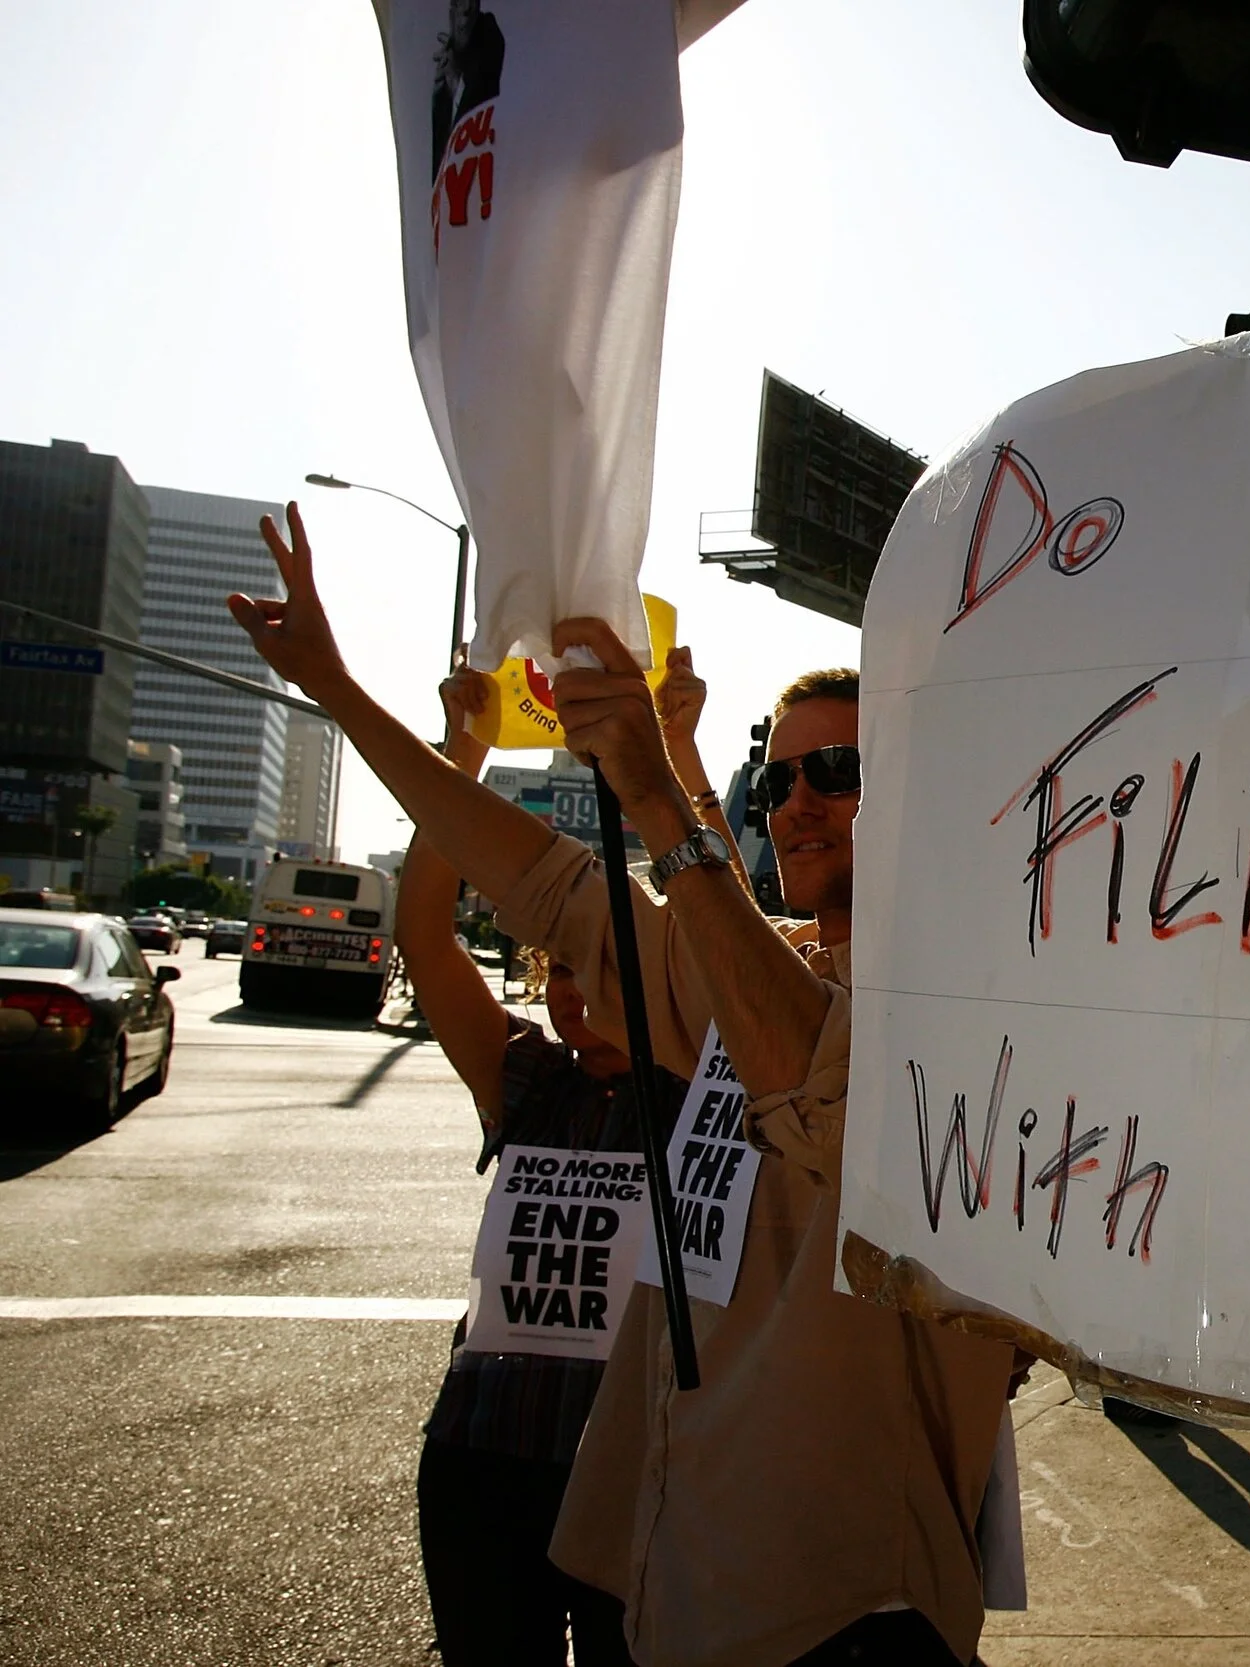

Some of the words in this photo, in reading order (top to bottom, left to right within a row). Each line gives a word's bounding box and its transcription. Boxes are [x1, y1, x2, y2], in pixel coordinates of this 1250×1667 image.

[944, 438, 1126, 634] Do
[8, 645, 69, 665] Fairfax
[518, 698, 558, 733] Bring
[512, 1155, 560, 1178] NO
[562, 1159, 648, 1183] MORE
[678, 1140, 746, 1201] THE
[906, 1036, 1169, 1265] With
[504, 1176, 643, 1202] STALLING:
[508, 1202, 620, 1242] END
[506, 1242, 611, 1288] THE
[501, 1285, 608, 1331] WAR
